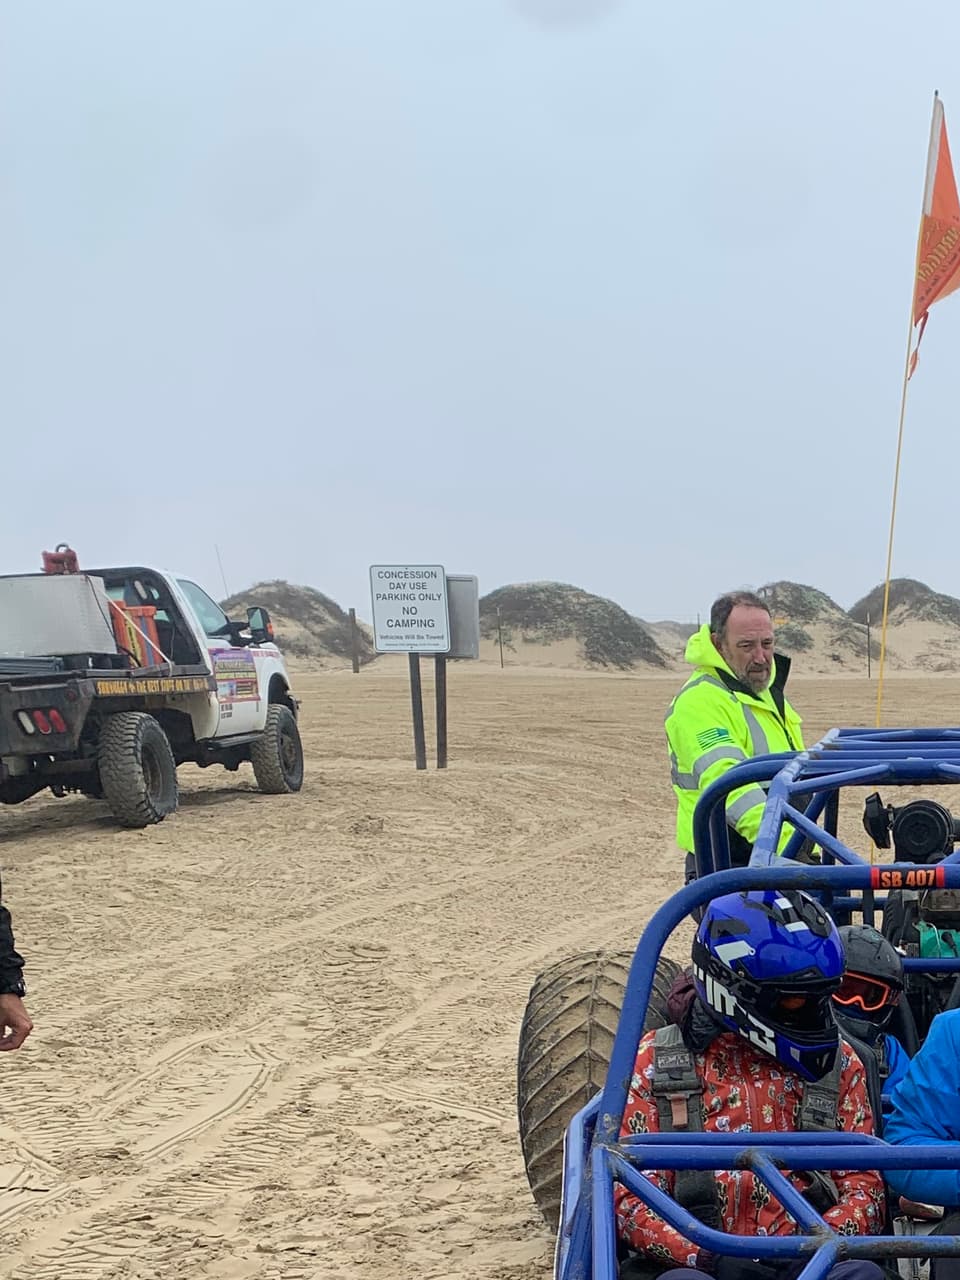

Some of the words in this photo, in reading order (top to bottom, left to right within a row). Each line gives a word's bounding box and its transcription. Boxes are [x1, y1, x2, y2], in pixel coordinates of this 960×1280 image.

[378, 571, 437, 579] CONCESSION
[389, 582, 407, 590] DAY
[409, 582, 428, 590] USE
[376, 593, 416, 601] PARKING
[418, 593, 442, 601] ONLY
[402, 606, 418, 615] NO
[386, 619, 435, 628] CAMPING
[881, 871, 902, 887] SB
[906, 870, 935, 886] 407
